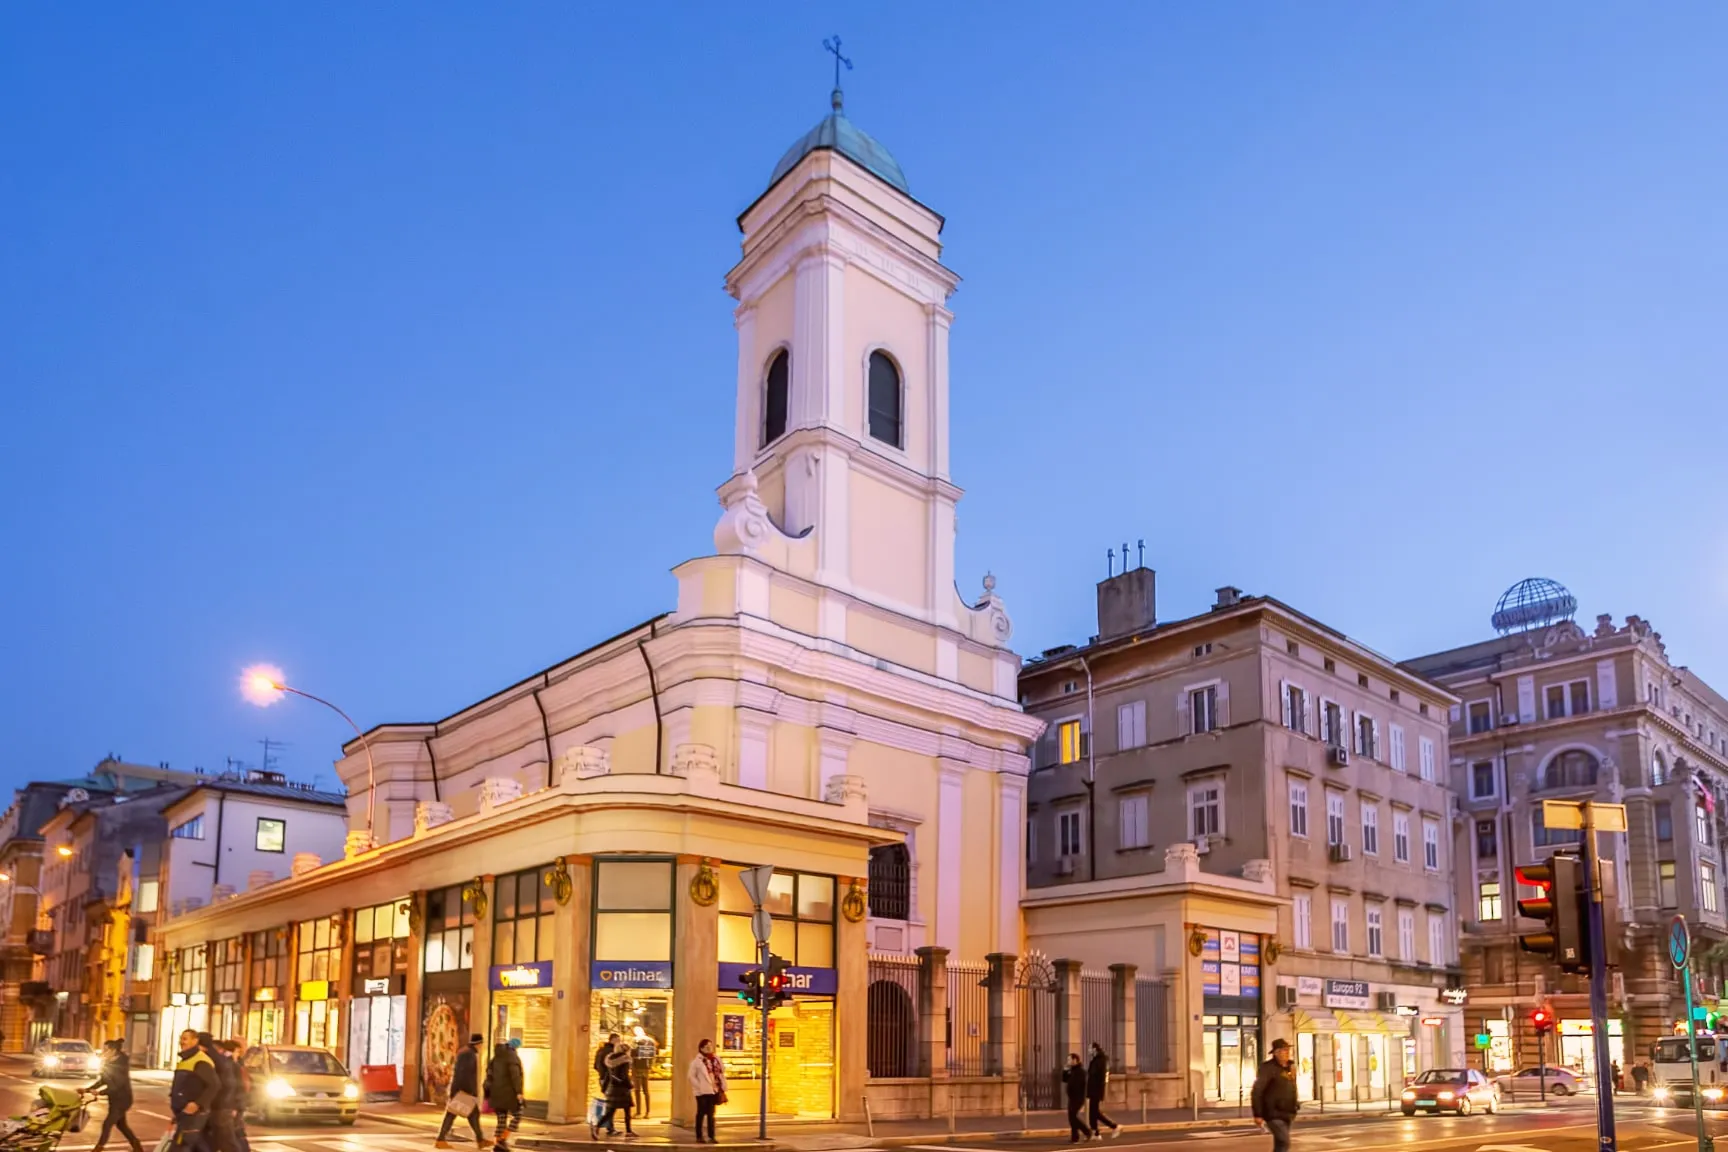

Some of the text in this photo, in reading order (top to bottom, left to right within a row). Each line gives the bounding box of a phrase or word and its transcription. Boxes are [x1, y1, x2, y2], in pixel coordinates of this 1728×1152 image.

[613, 967, 664, 982] mlinar
[1332, 981, 1354, 994] Europa
[1354, 983, 1364, 994] 92
